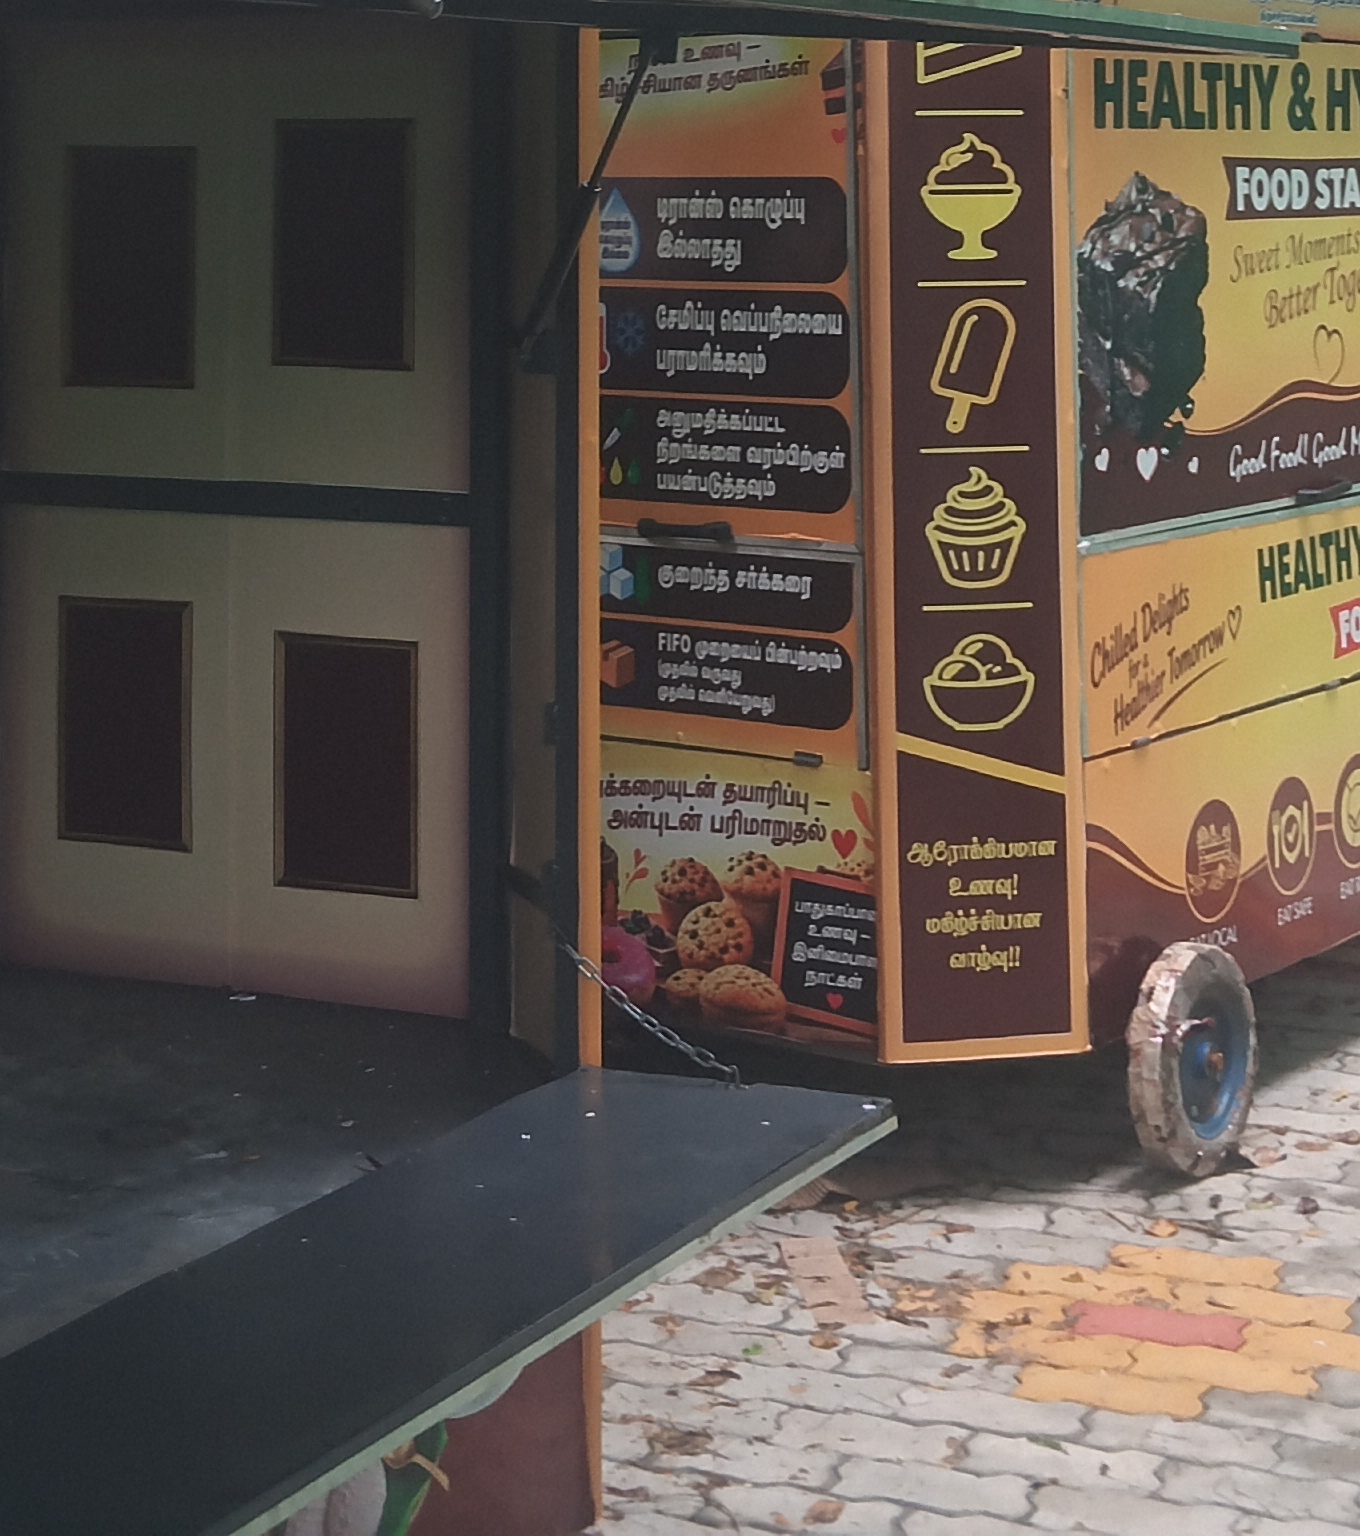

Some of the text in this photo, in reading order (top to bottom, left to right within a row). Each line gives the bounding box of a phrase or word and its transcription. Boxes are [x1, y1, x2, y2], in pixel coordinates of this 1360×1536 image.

[683, 41, 742, 63] உணவு
[706, 54, 810, 93] தருணங்கள்
[1093, 57, 1279, 130] HEALTHY
[1287, 62, 1318, 132] &
[1236, 165, 1309, 212] FOOD
[656, 189, 806, 229] டிரான்ஸ் கொழுப்பு
[656, 229, 742, 272] இல்லாதது
[1229, 226, 1360, 283] Sweet Moments
[655, 301, 844, 341] சேமிப்பு வெப்பநிலையை
[1263, 279, 1320, 329] Better
[656, 342, 768, 380] பராமரிக்கவும்
[655, 408, 787, 438] அனுமதிக்கப்பட்ட
[656, 437, 846, 473] நிறங்களை வரம்பிற்குள்
[1229, 442, 1267, 482] Good
[1270, 436, 1309, 473] Food!
[1312, 430, 1348, 465] Good
[656, 469, 776, 501] பயன்படுத்தவும்
[658, 562, 813, 600] குறைந்த சர்க்கரை
[658, 632, 691, 654] FIFO
[1090, 582, 1190, 689] Chilled Delights
[1113, 620, 1226, 737] Healthier Tomorrow
[600, 773, 717, 805] க்கறையுடன்
[722, 780, 809, 815] தயாரிப்பு
[606, 803, 827, 847] அன்புடன் பரிமாறுதல்
[906, 836, 1057, 867] ஆரோக்கியமான
[948, 874, 1018, 900] உணவு!
[807, 924, 858, 945] உணவு
[925, 908, 1043, 937] மகிழ்ச்சியான
[949, 944, 1020, 972] வாழ்வு!!
[804, 970, 863, 990] நாட்கள்
